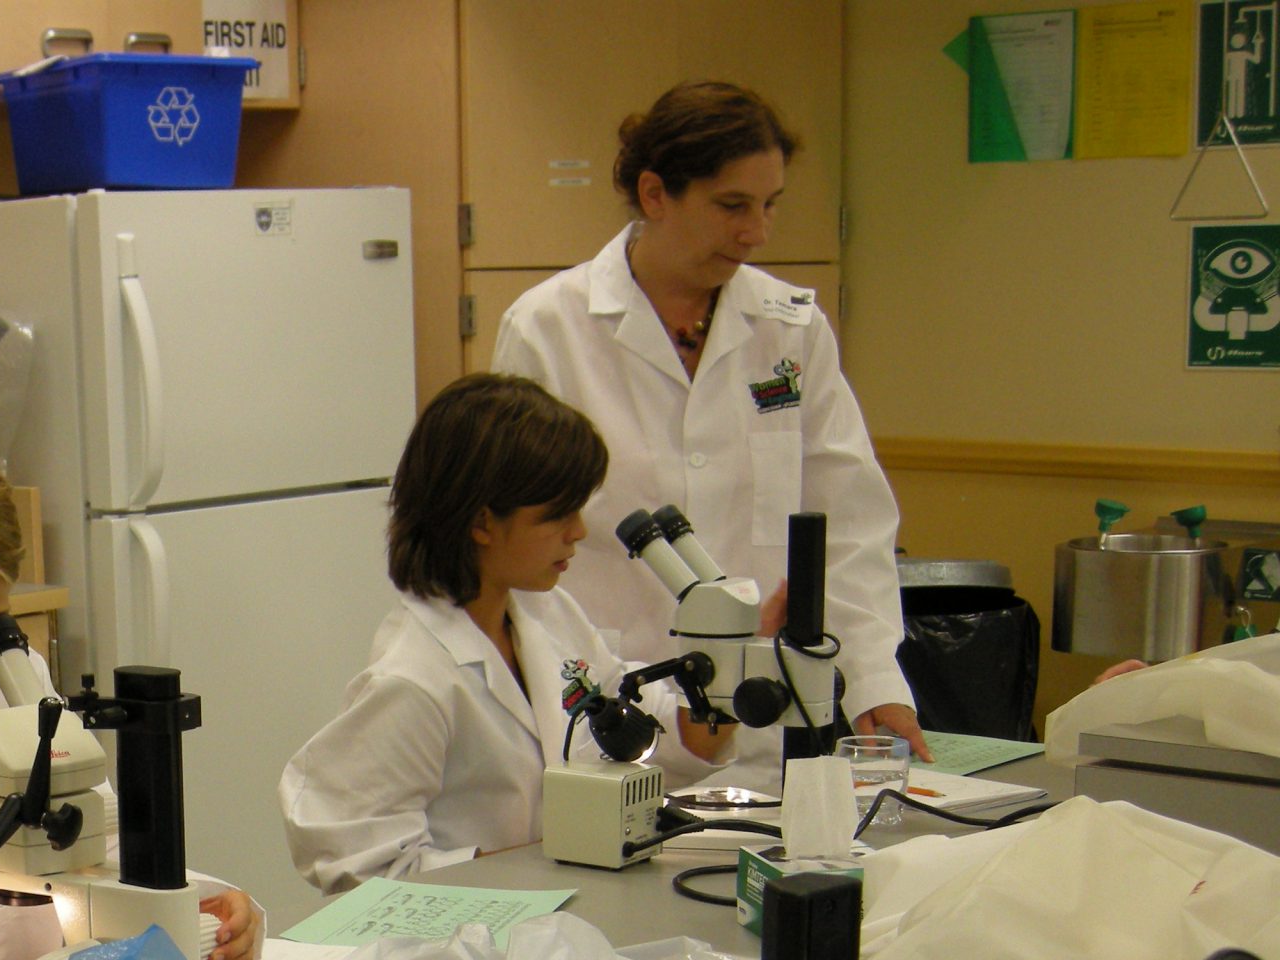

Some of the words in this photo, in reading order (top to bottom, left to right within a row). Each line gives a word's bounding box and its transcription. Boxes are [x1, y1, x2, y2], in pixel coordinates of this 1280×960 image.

[204, 21, 255, 48] FIRST
[261, 22, 286, 48] AID
[243, 61, 262, 87] IT
